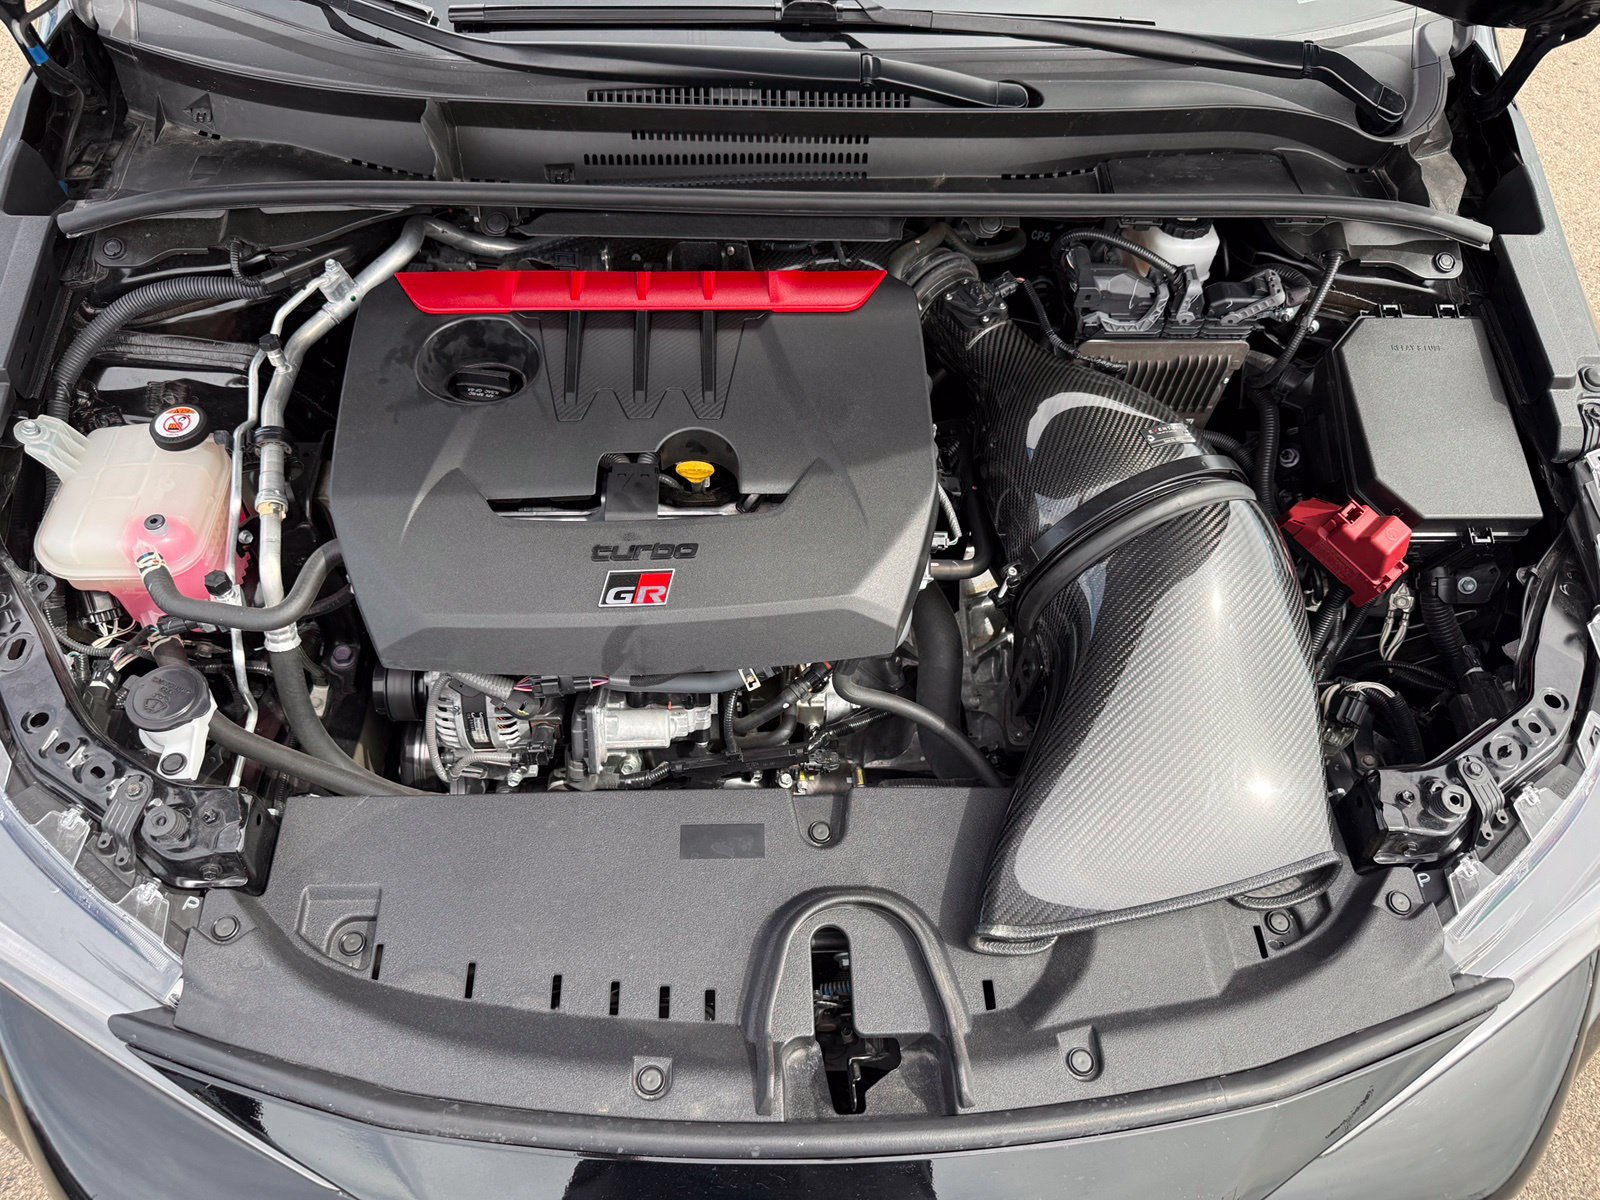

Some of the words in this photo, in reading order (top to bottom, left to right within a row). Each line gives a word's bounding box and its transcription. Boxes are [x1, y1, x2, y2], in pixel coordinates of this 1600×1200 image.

[591, 543, 699, 562] turbo
[605, 586, 667, 604] GR
[182, 895, 200, 910] P
